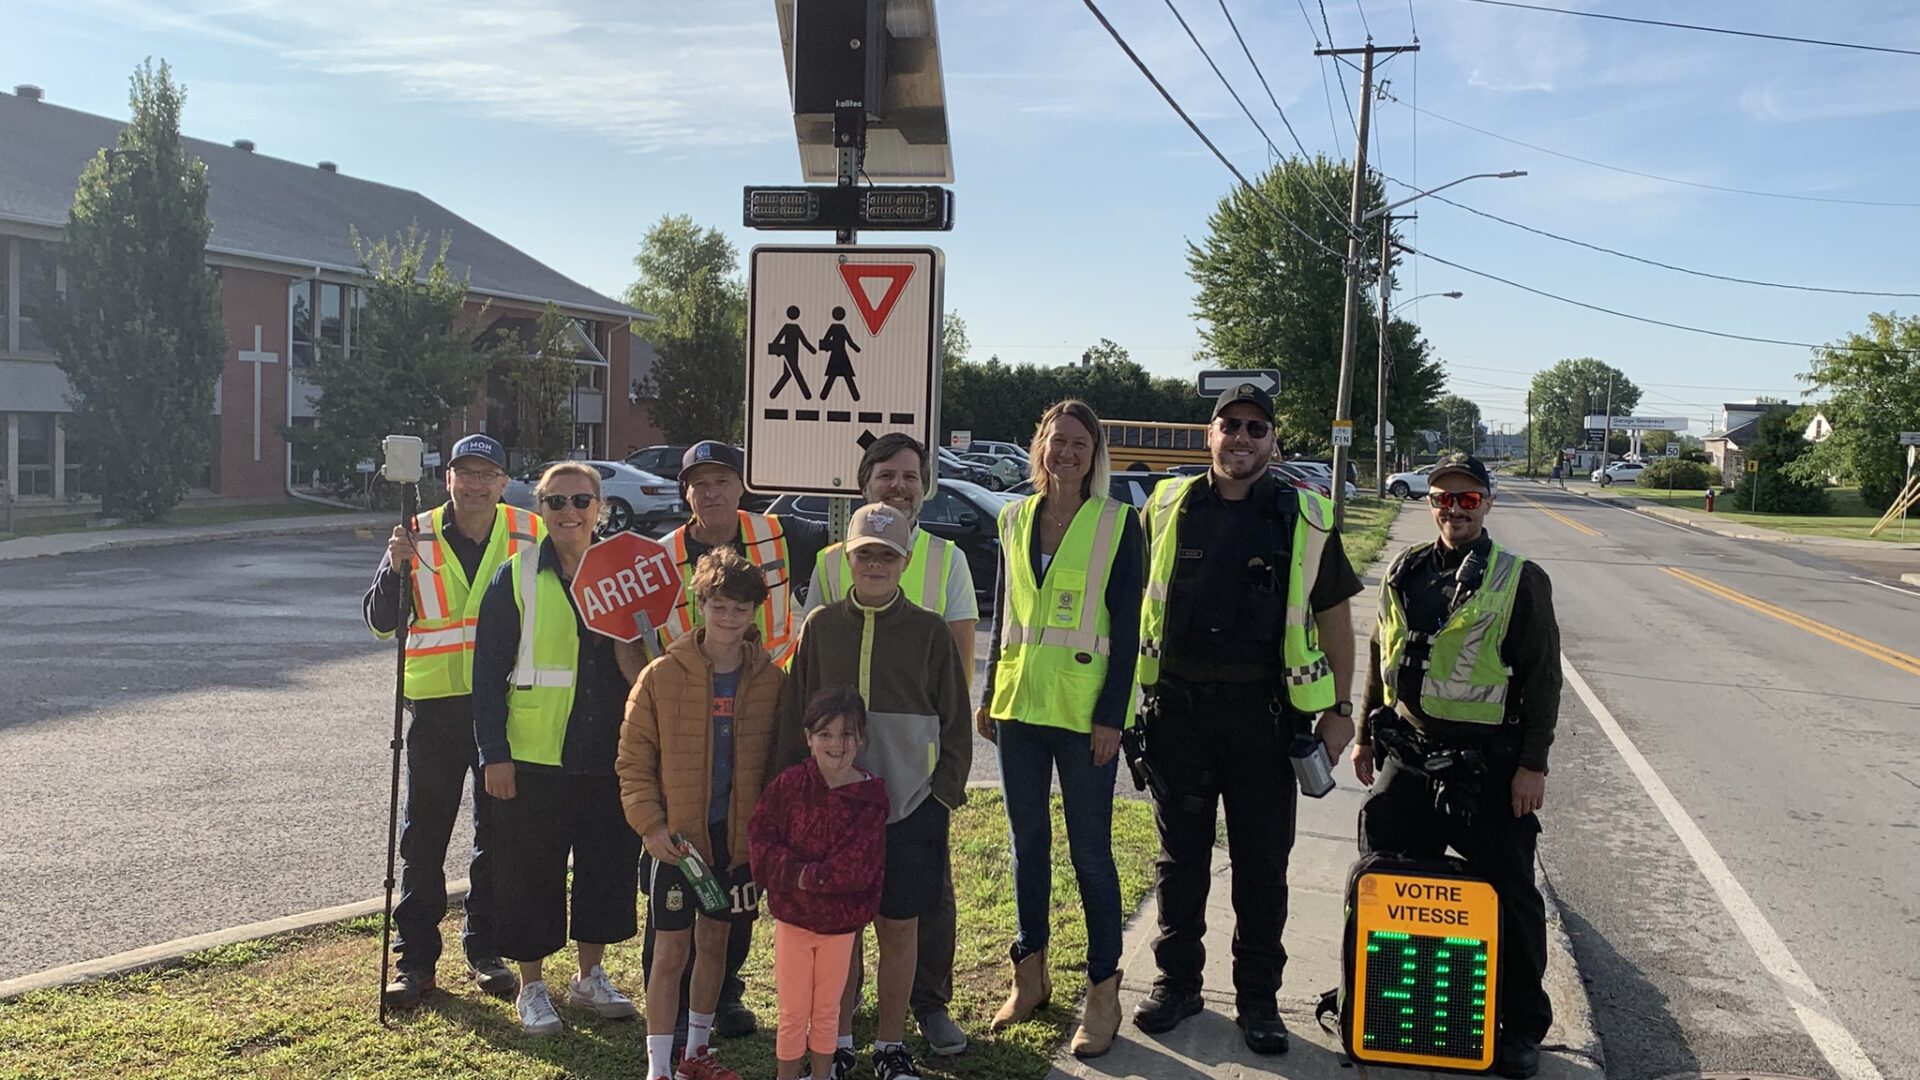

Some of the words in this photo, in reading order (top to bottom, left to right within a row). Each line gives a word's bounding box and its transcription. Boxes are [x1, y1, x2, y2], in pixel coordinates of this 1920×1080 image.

[1334, 435, 1349, 443] FIN
[1667, 447, 1679, 456] 50
[583, 552, 672, 621] ARRÊT
[729, 881, 758, 914] 10
[1395, 882, 1462, 902] VOTRE
[1387, 904, 1470, 926] VITESSE
